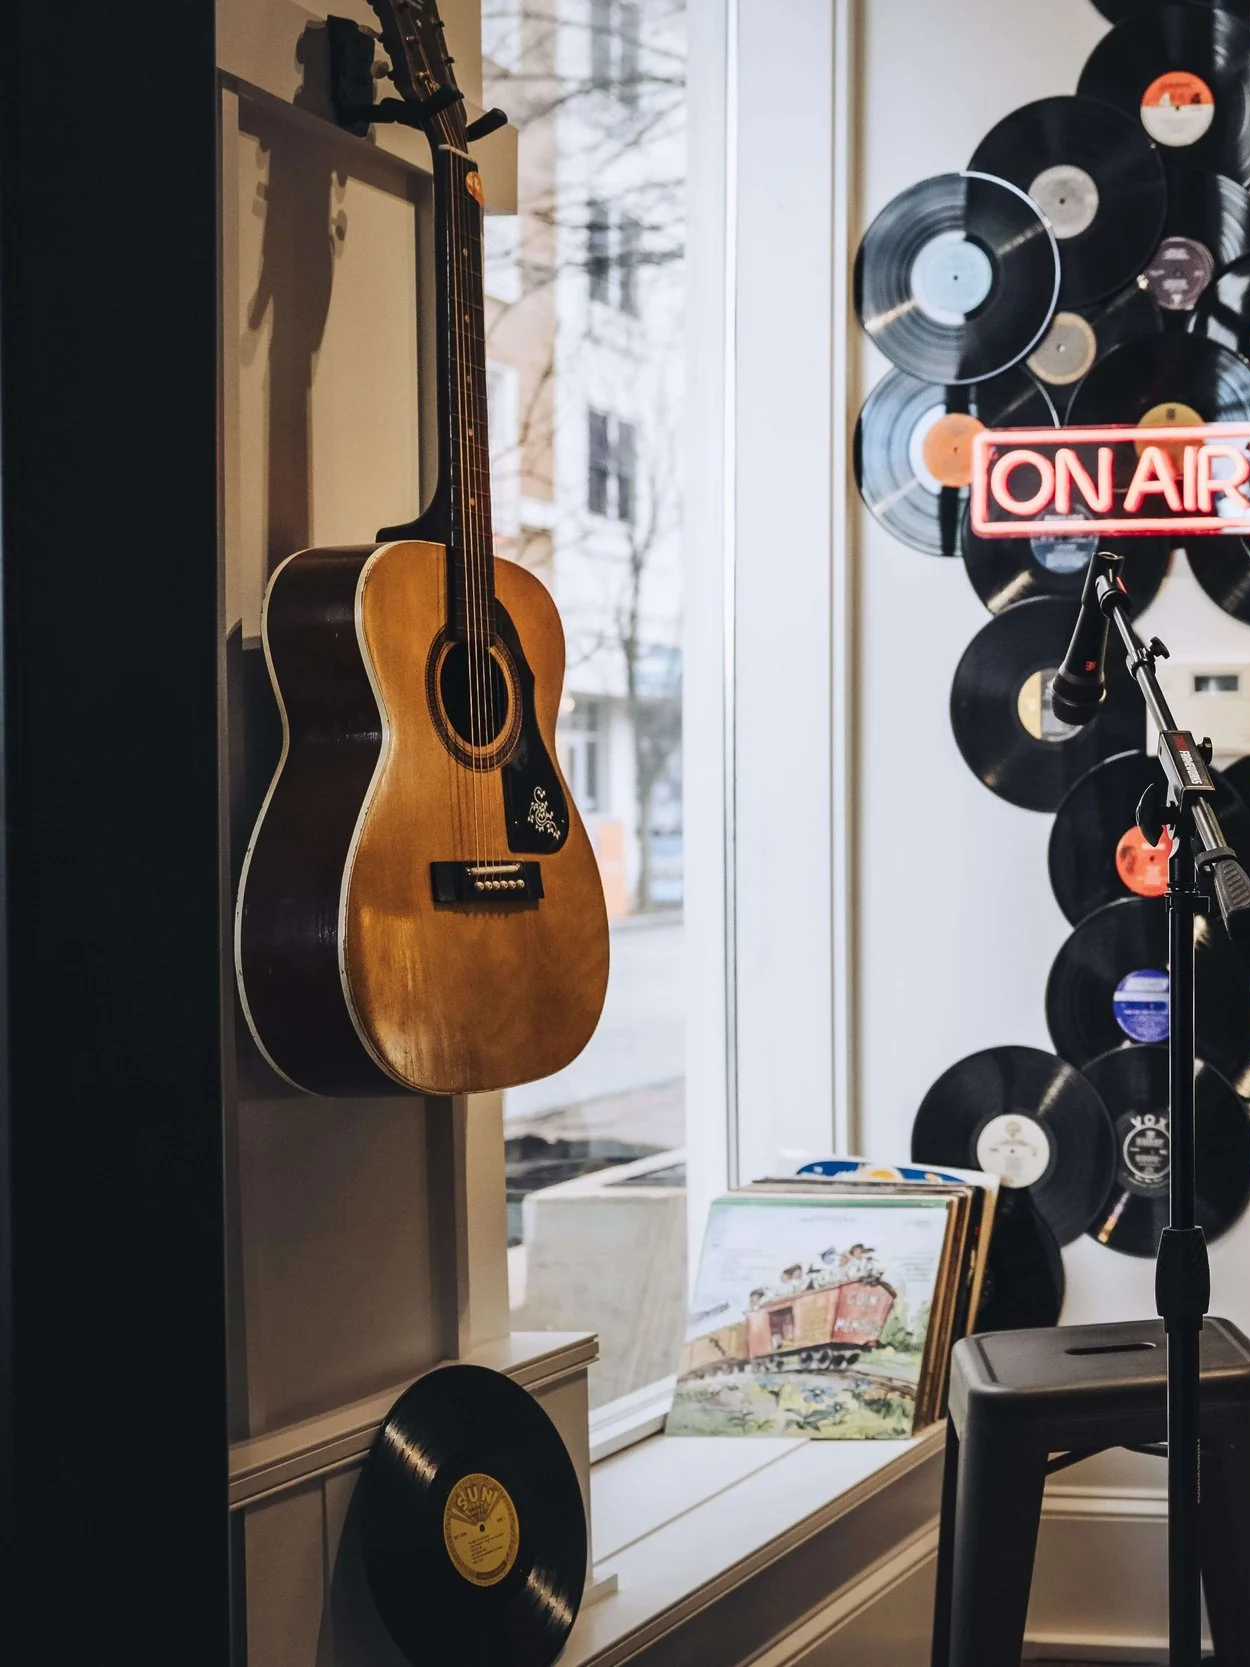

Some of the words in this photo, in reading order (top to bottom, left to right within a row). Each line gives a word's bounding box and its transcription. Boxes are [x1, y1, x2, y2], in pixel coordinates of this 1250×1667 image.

[991, 447, 1114, 515] ON
[1123, 445, 1250, 513] AIR
[1130, 1114, 1168, 1129] VOX
[457, 1486, 498, 1510] SUN
